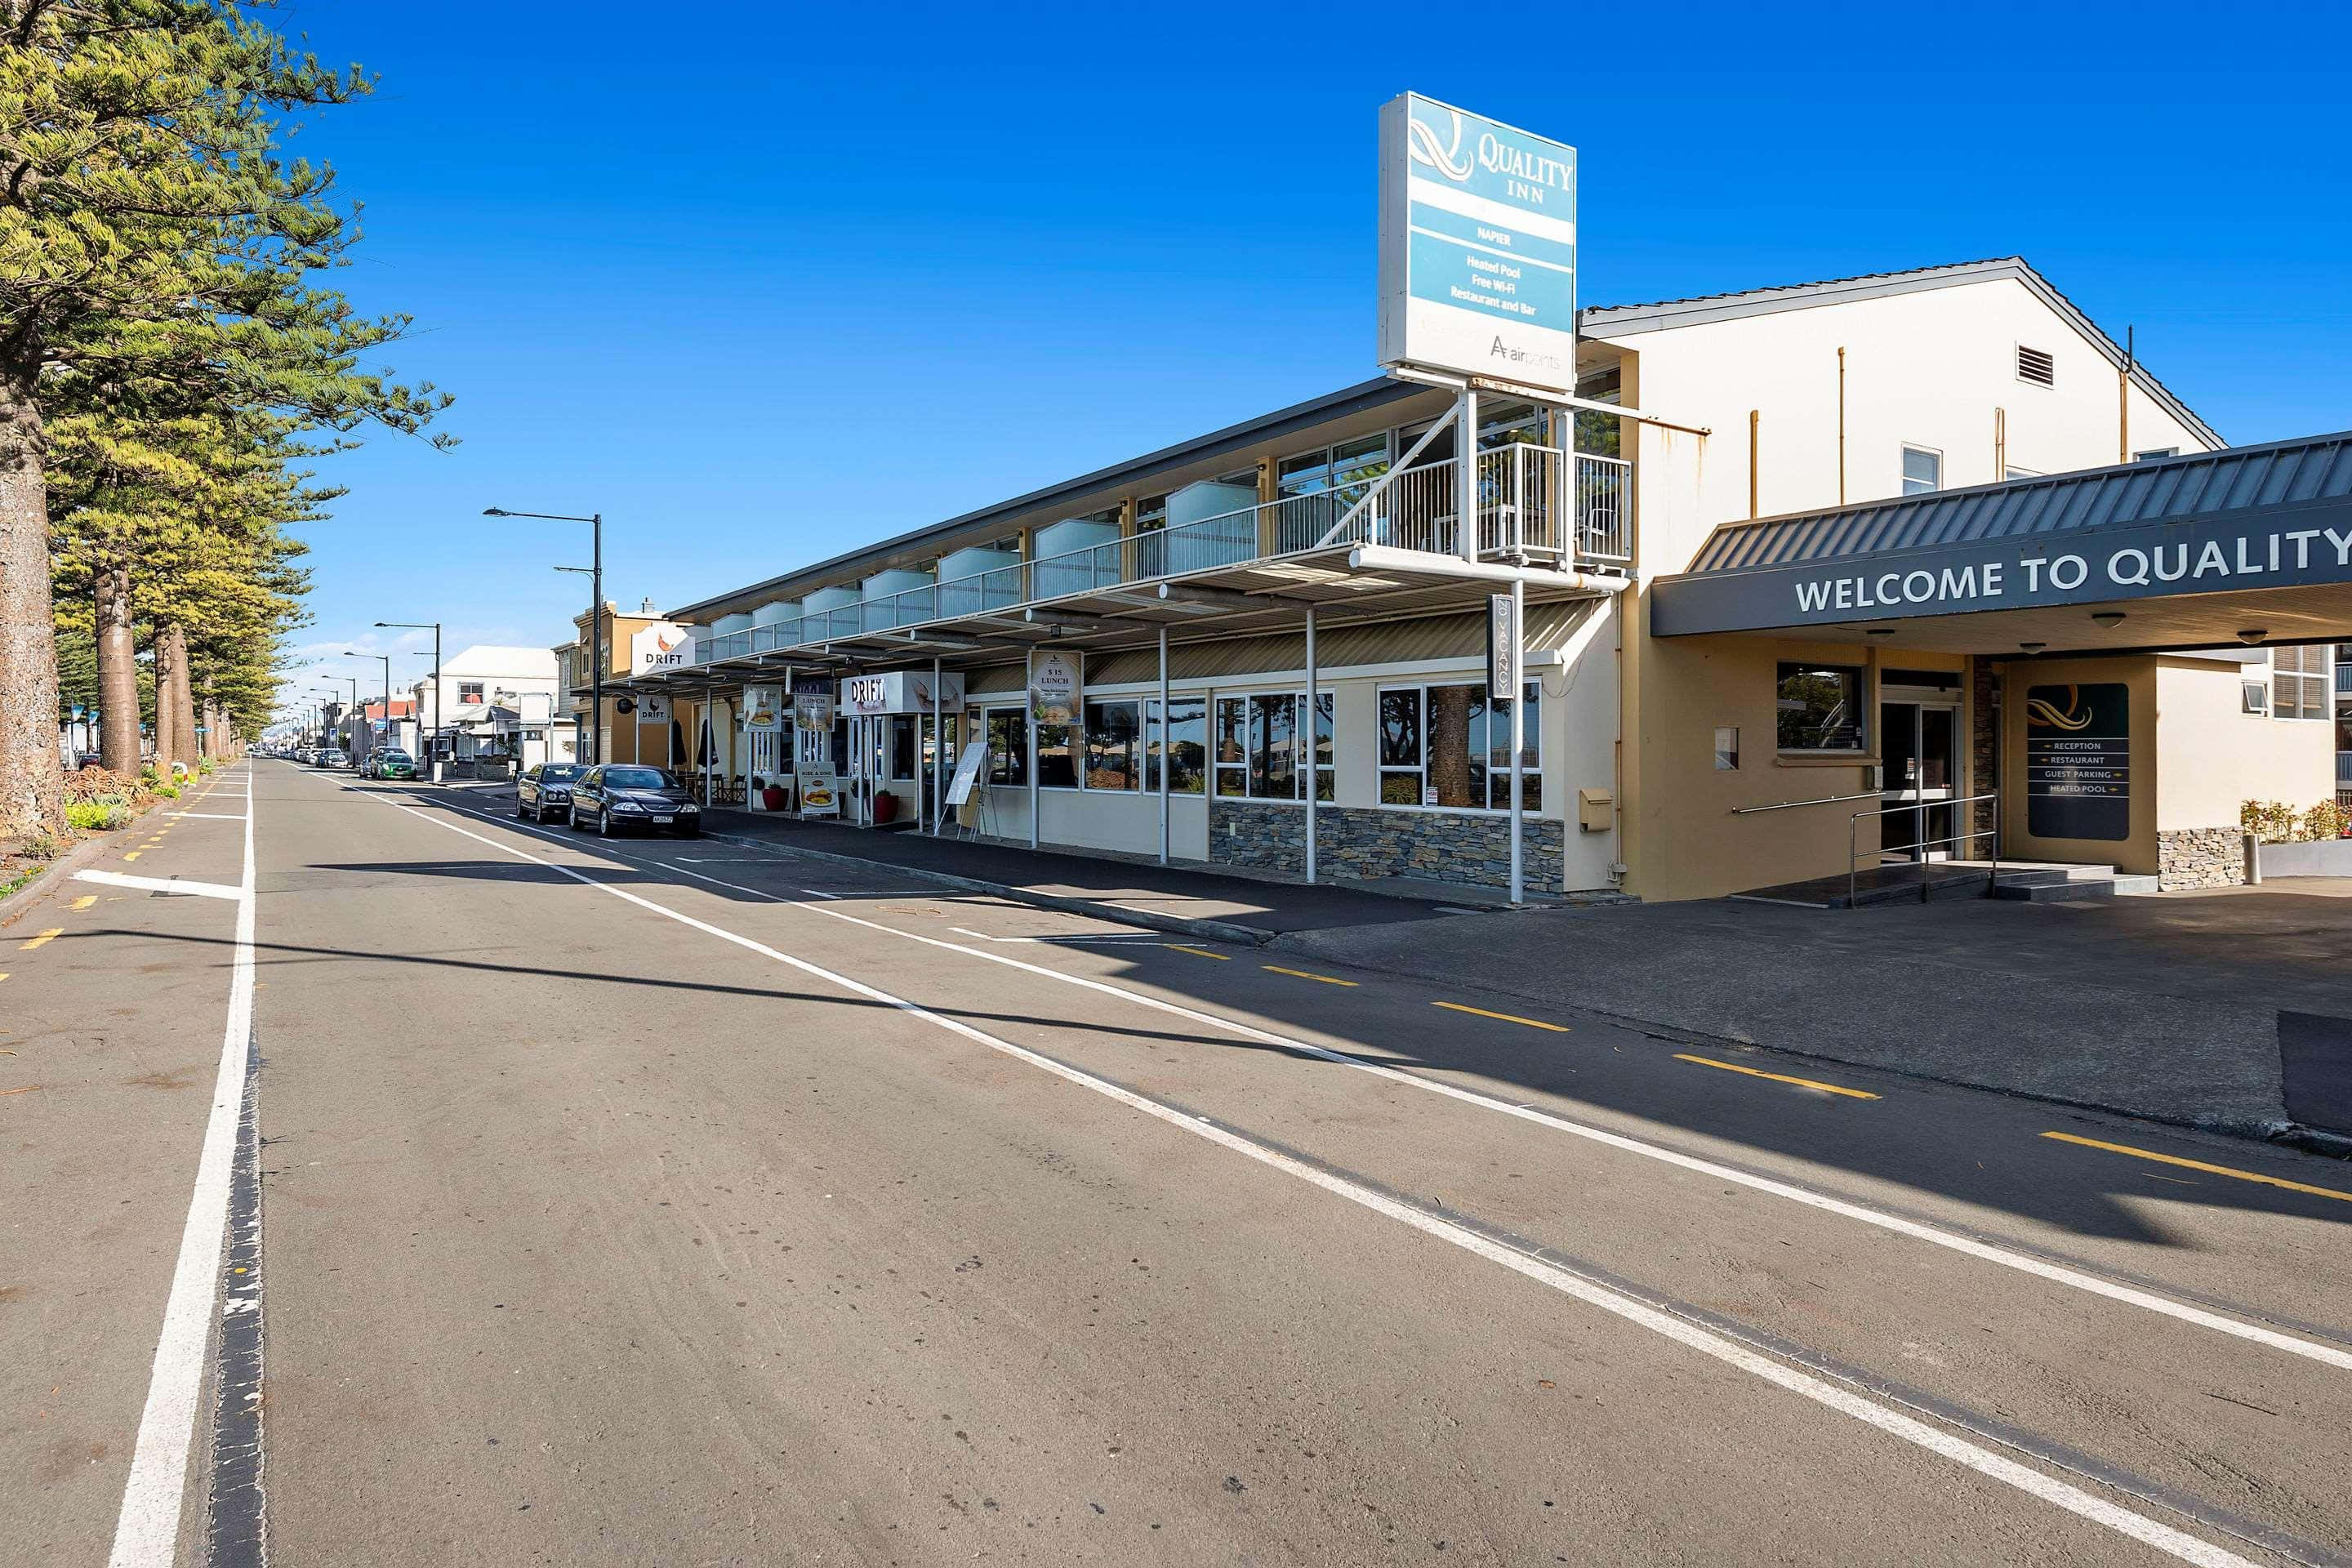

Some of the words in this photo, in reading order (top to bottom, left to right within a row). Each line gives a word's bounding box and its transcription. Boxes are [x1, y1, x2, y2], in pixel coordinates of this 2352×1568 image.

[1478, 132, 1573, 192] QUALITY
[1507, 179, 1544, 204] INN
[1477, 226, 1511, 247] NAPIER
[1466, 254, 1499, 274] Heated
[1500, 263, 1521, 279] Pool
[1472, 274, 1492, 289] Free
[1450, 284, 1500, 309] Restaurant
[1501, 299, 1519, 313] and
[1520, 301, 1536, 316] Bar
[1795, 561, 2003, 612] WELCOME
[2020, 554, 2088, 594] TO
[2107, 528, 2352, 586] QUALITY
[1498, 599, 1508, 616] NO
[646, 653, 683, 665] DRIFT
[1498, 621, 1509, 695] VACANCY
[851, 678, 882, 702] DRIFT
[2053, 742, 2101, 751] RECEPTION
[2051, 756, 2105, 764] RESTAURANT
[2044, 770, 2071, 778] GUEST
